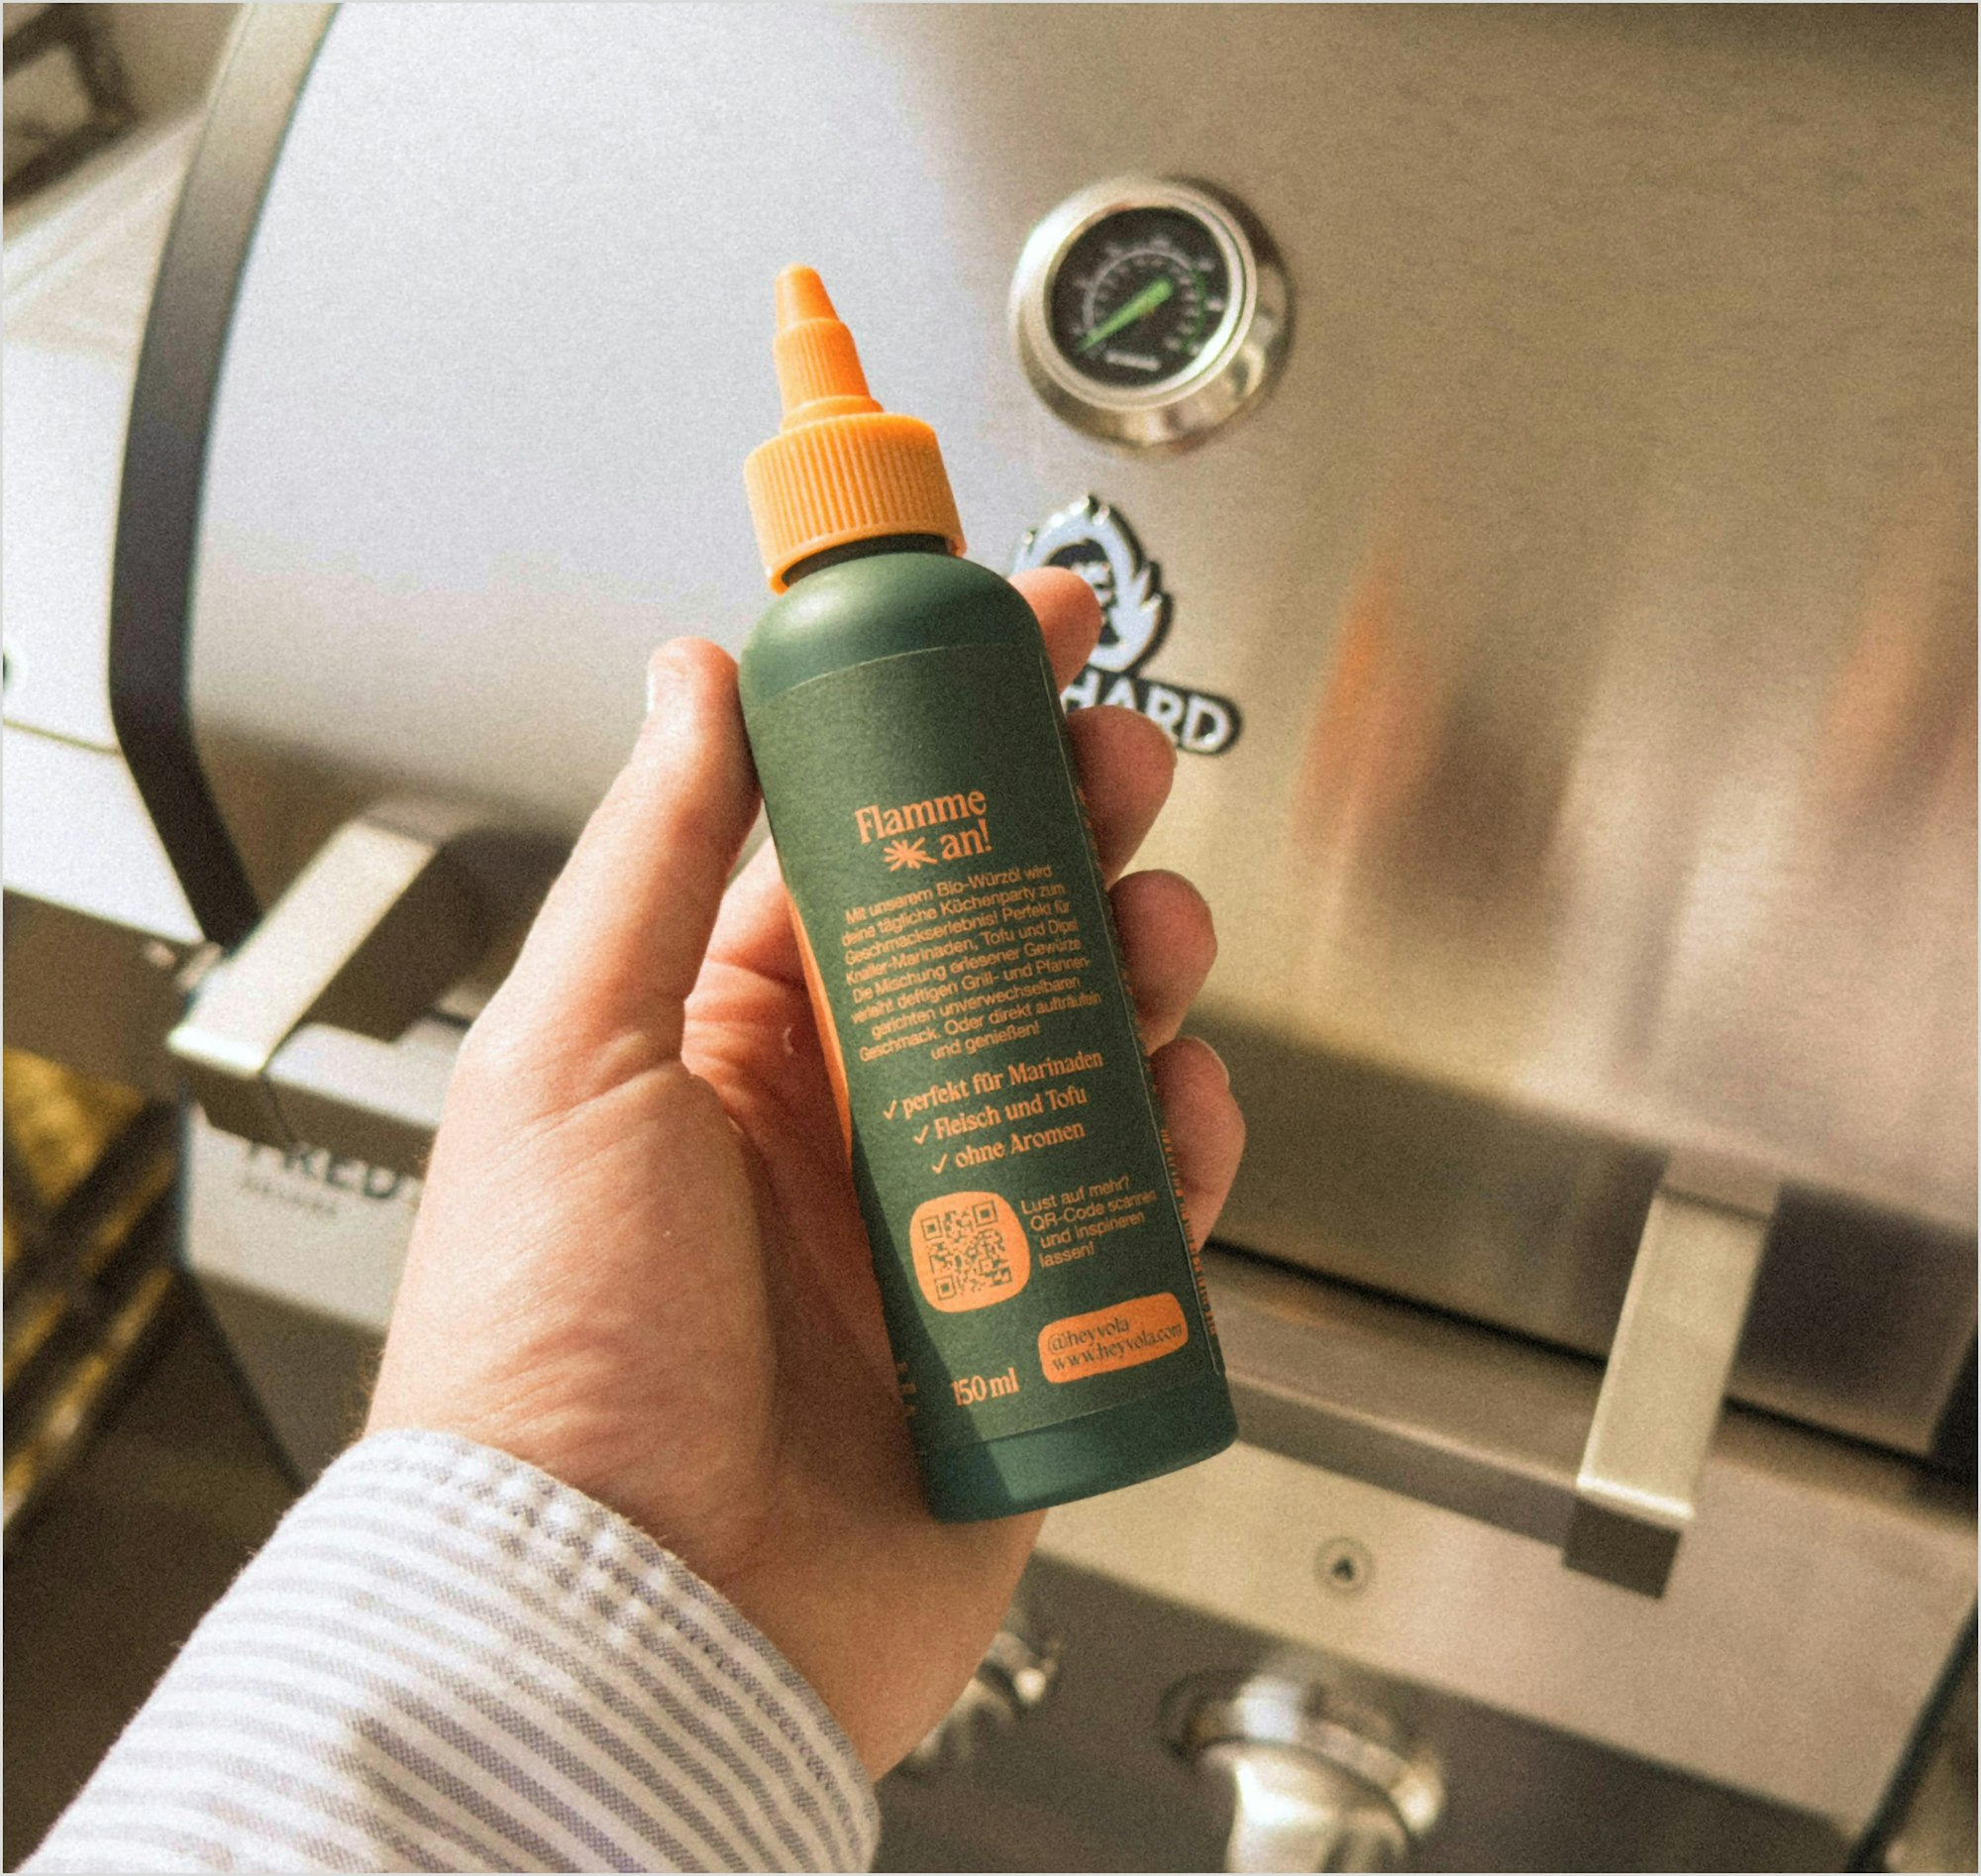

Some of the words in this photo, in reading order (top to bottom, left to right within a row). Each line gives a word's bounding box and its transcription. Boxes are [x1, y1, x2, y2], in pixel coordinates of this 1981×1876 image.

[855, 790, 988, 844] Flamme
[939, 818, 993, 861] an!
[842, 927, 876, 947] deine
[878, 907, 938, 934] tägliche
[940, 886, 1036, 916] Küchenparty
[1038, 883, 1066, 897] zum
[845, 906, 868, 925] Mit
[869, 888, 933, 917] unserem
[936, 867, 1021, 897] Bio-Würzöl
[1025, 865, 1053, 880] wird
[845, 909, 998, 966] Geschmackserlebnis!
[1001, 901, 1052, 922] Perfekt
[1054, 899, 1071, 913] für
[846, 939, 979, 987] Knaller-Marinaden,
[982, 928, 1015, 946] Tofu
[1018, 921, 1045, 939] und
[1048, 917, 1080, 935] Dips!
[851, 998, 895, 1024] verleiht
[897, 982, 959, 1009] deftigen
[962, 970, 999, 991] Grill-
[1003, 963, 1033, 981] und
[1035, 956, 1091, 975] Pfannen-
[853, 987, 874, 1004] Die
[875, 965, 947, 996] Mischung
[950, 948, 1021, 974] erlesener
[1023, 937, 1082, 958] Gewürze
[860, 1026, 942, 1062] Geschmack.
[945, 1014, 986, 1036] Oder
[989, 1002, 1032, 1024] direkt
[1036, 991, 1102, 1015] aufträufeln
[873, 1008, 937, 1041] gerichten
[939, 977, 1082, 1017] unverwechselbaren
[931, 1039, 963, 1061] und
[965, 1019, 1040, 1056] genießen!
[902, 1077, 971, 1119] perfekt
[973, 1070, 1004, 1094] für
[1008, 1050, 1104, 1088] Marinaden
[934, 1104, 1002, 1140] Fleisch
[1005, 1093, 1044, 1119] und
[1046, 1084, 1089, 1111] Tofu
[955, 1139, 1005, 1170] ohne
[1010, 1120, 1087, 1155] Aromen
[1021, 1194, 1057, 1215] Lust
[1061, 1186, 1086, 1205] auf
[1090, 1174, 1131, 1198] mehr?
[1030, 1202, 1105, 1232] QR-Code
[1107, 1190, 1158, 1211] scannen
[1039, 1240, 1095, 1269] lassen!
[1040, 1229, 1072, 1249] und
[1076, 1210, 1145, 1238] inspirieren
[1047, 1316, 1130, 1355] @heyvola
[1051, 1323, 1184, 1372] www.heyvola.com
[951, 1375, 988, 1407] 150
[989, 1367, 1020, 1398] ml
